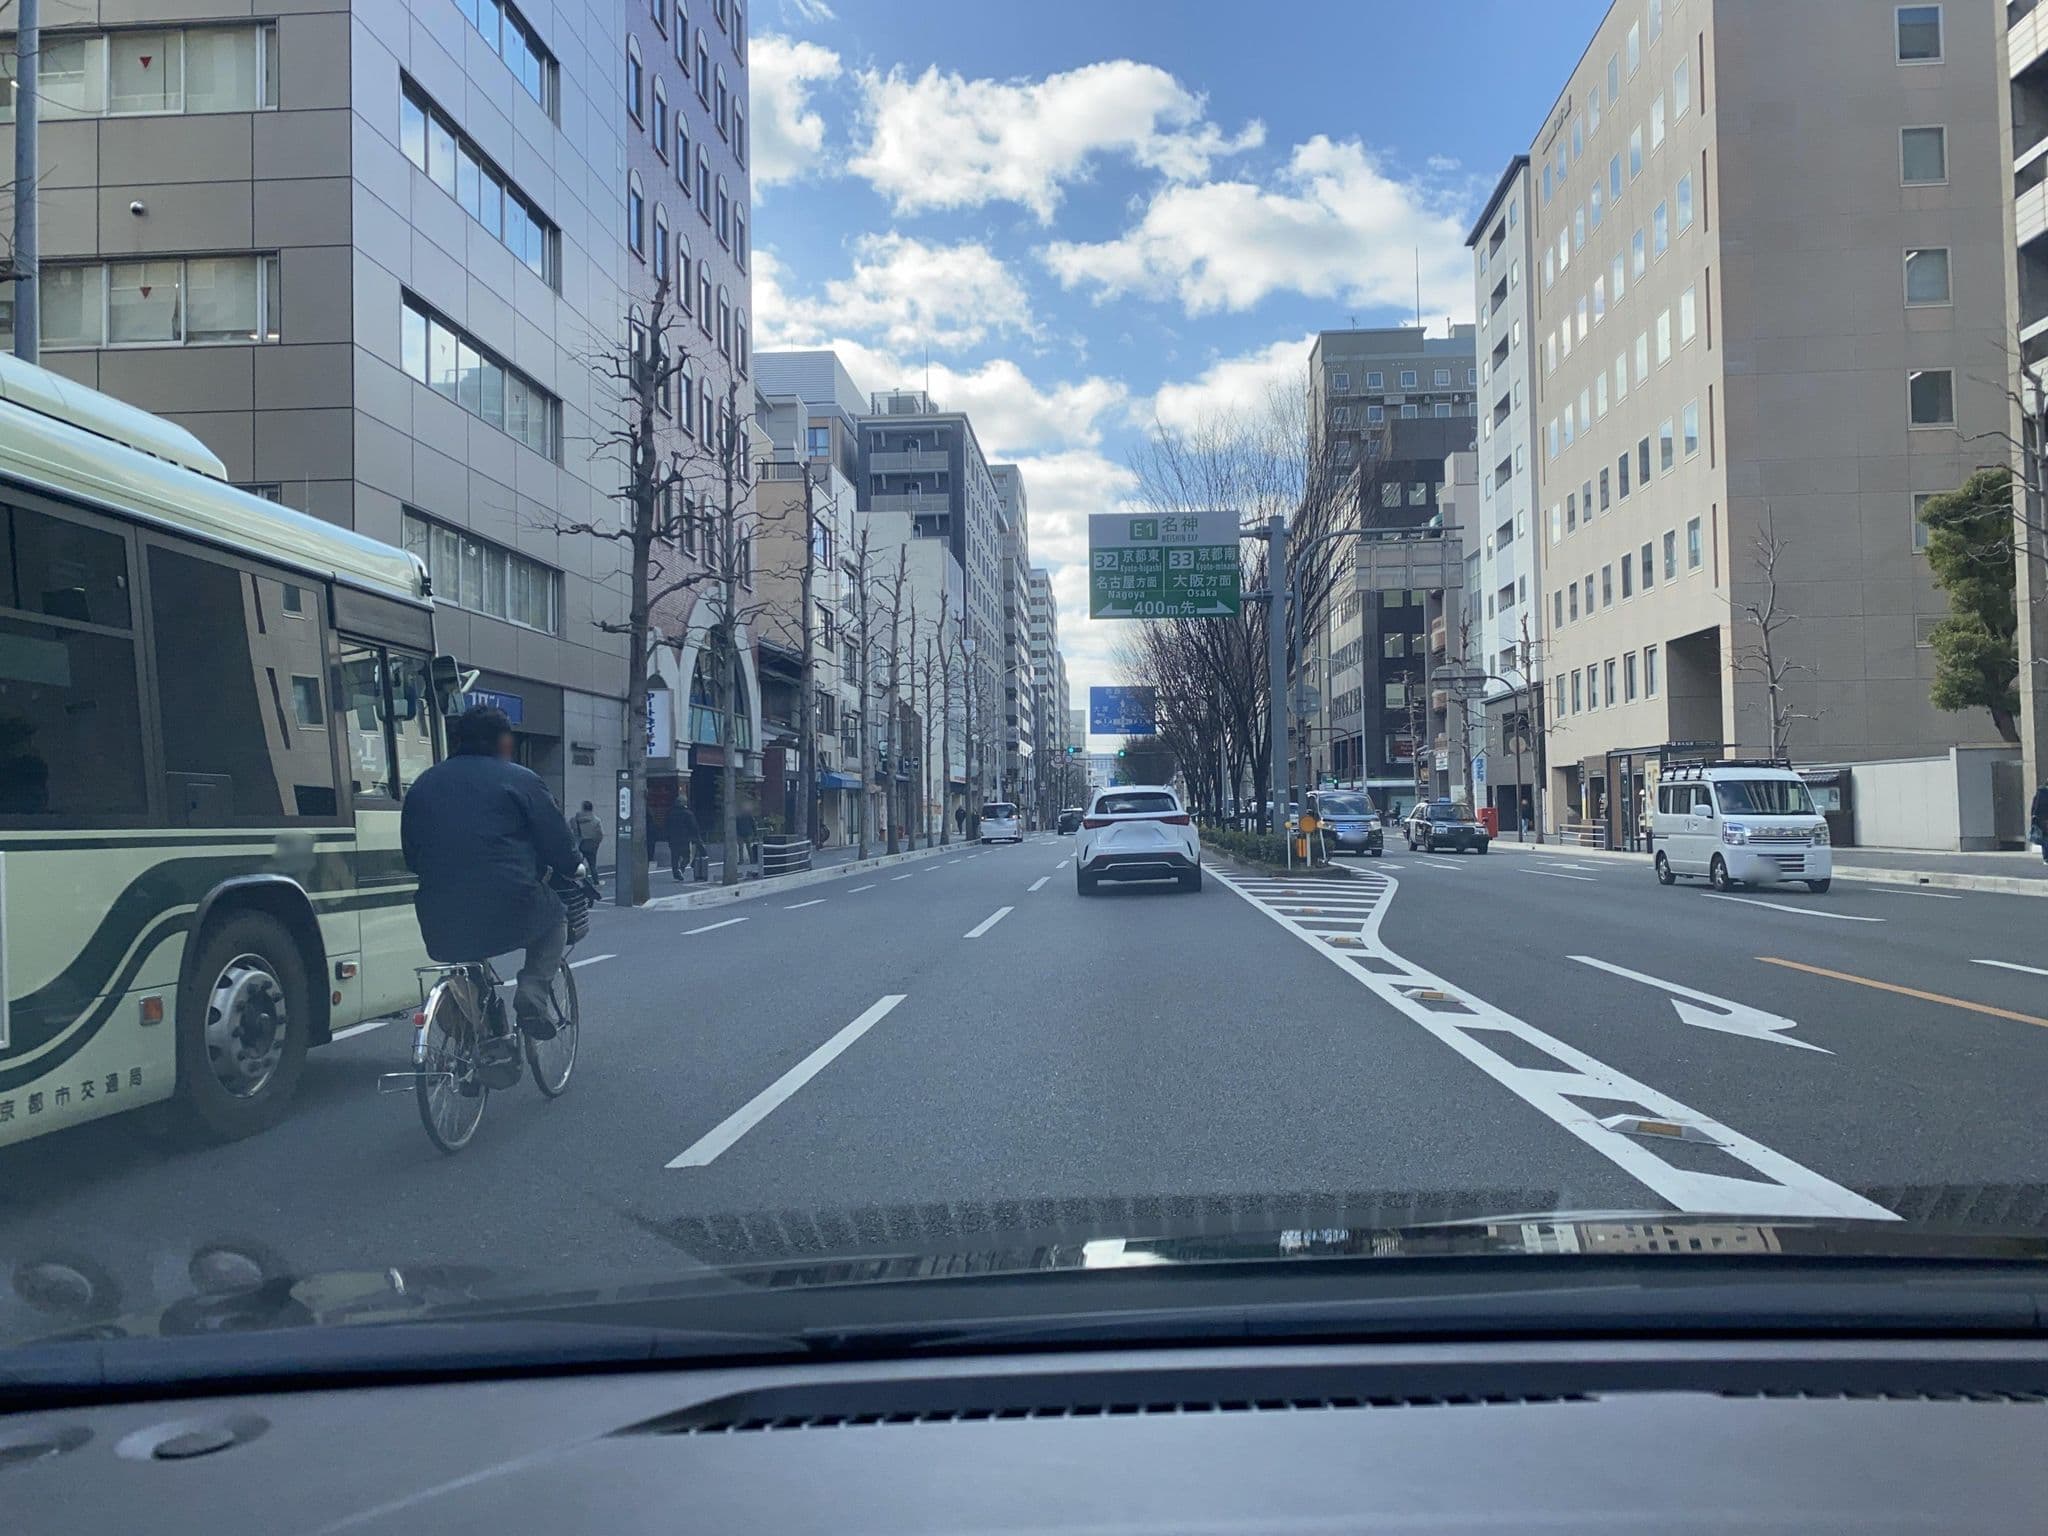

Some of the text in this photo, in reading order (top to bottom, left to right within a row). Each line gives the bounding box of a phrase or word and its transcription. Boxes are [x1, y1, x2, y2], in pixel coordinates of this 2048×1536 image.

[1134, 522, 1154, 537] E1
[1162, 516, 1199, 532] 名神
[1095, 550, 1160, 568] 32 京都東
[1171, 547, 1236, 566] 33 京都南
[1096, 576, 1157, 589] 名古屋方面
[1173, 574, 1232, 587] 大阪方面
[1108, 590, 1145, 599] Nagoya
[1187, 588, 1217, 598] Osaka
[1134, 601, 1196, 615] 400m先
